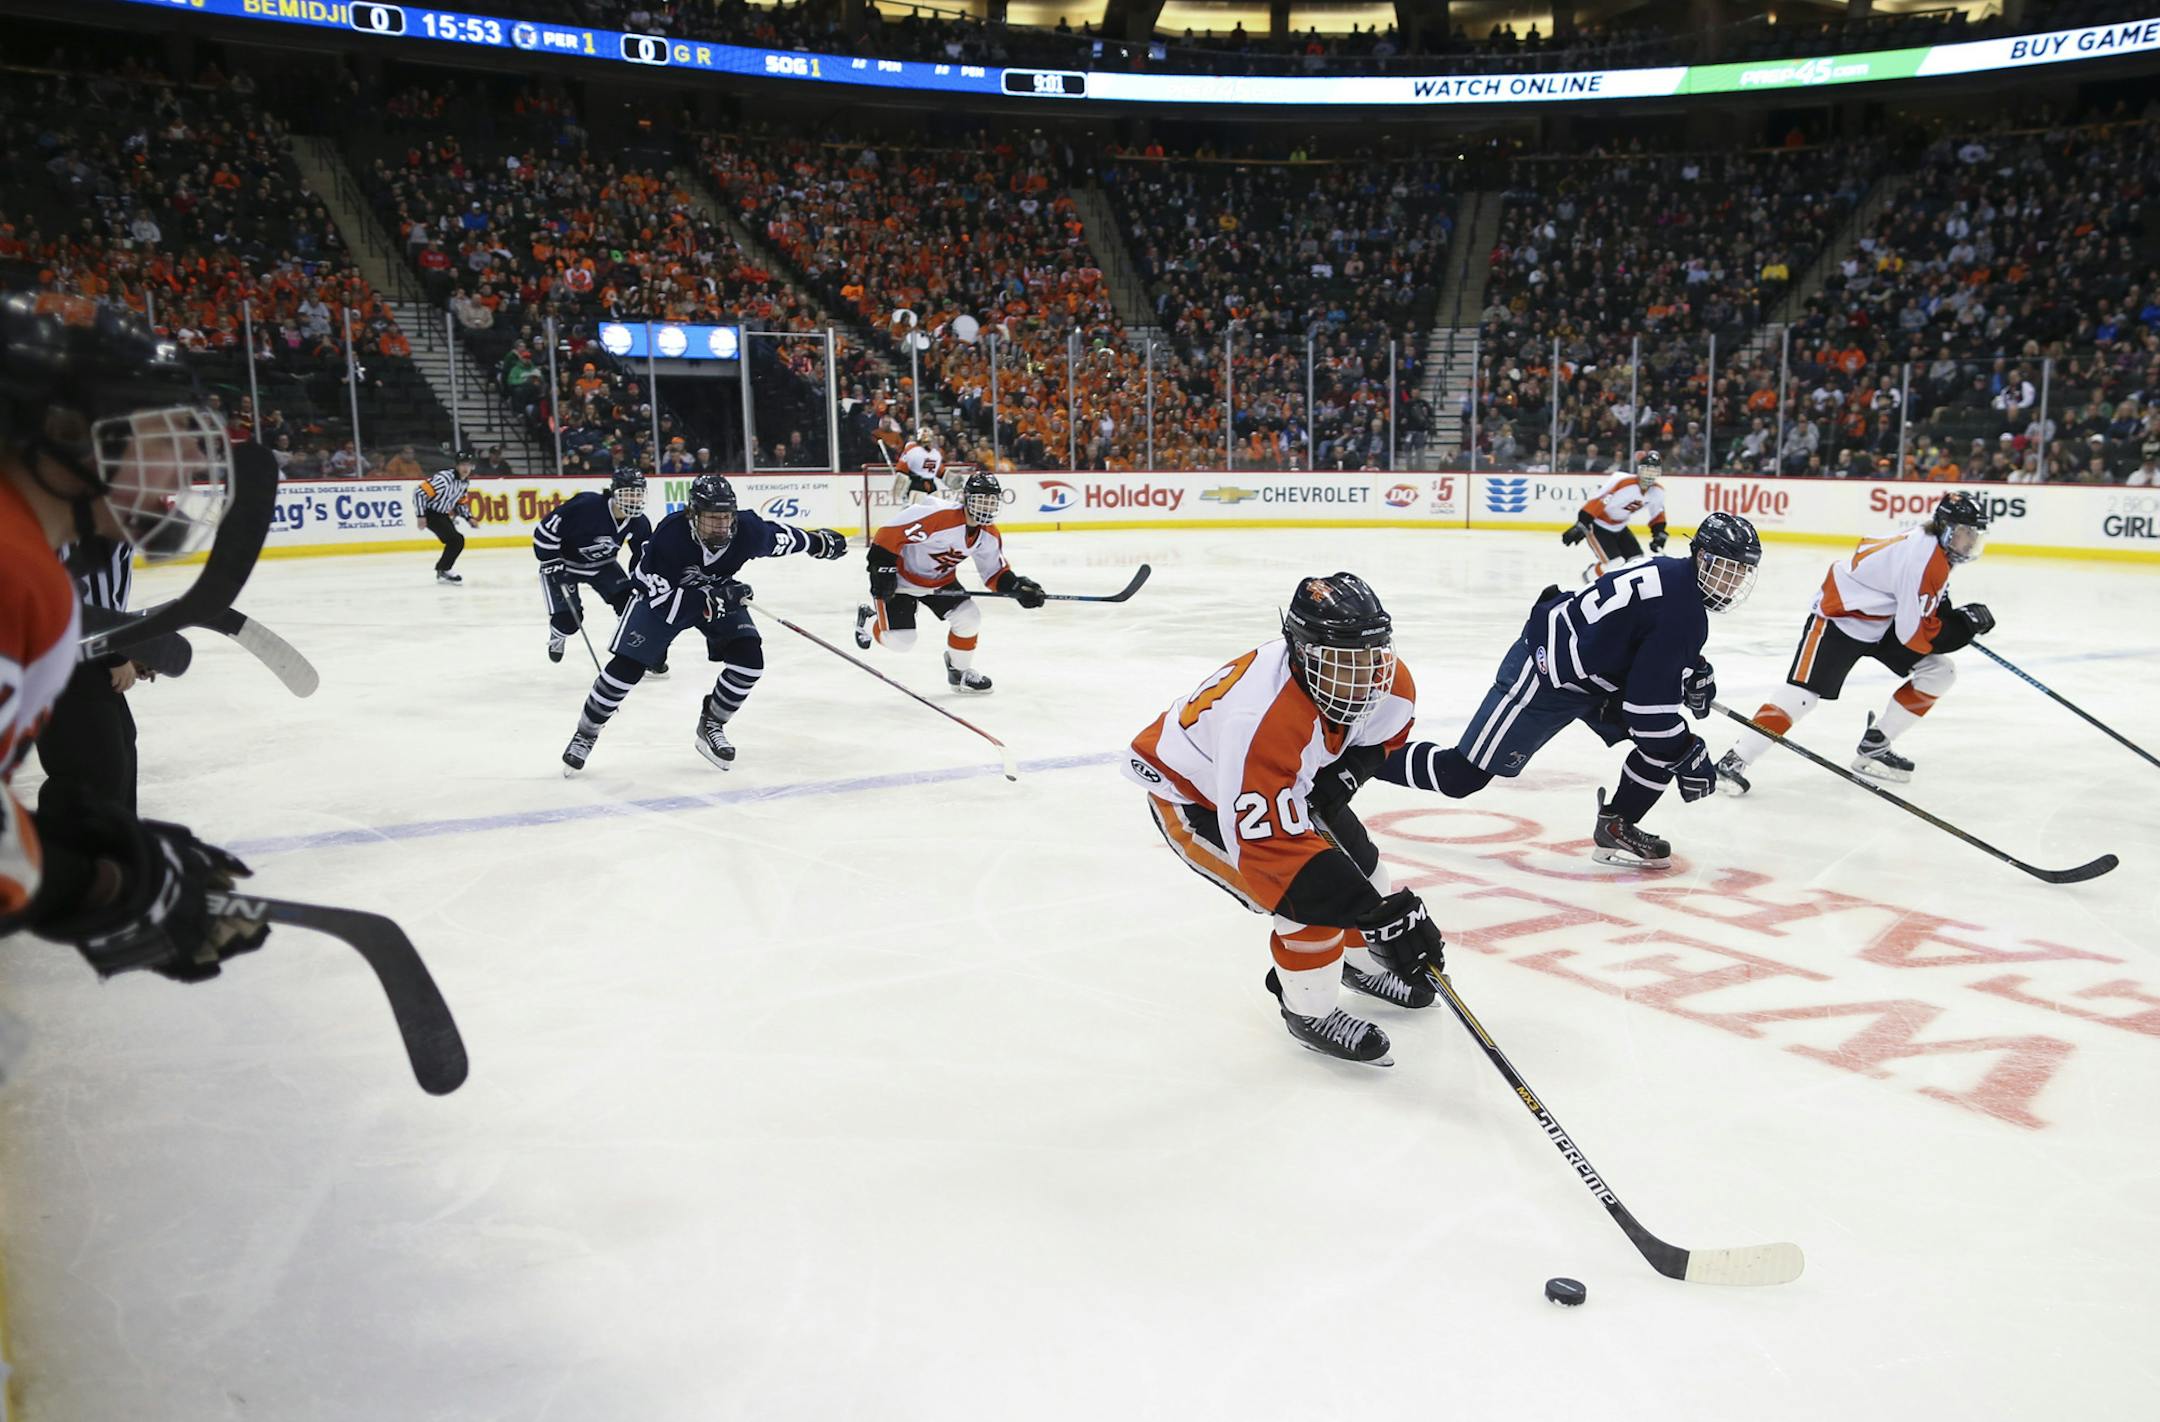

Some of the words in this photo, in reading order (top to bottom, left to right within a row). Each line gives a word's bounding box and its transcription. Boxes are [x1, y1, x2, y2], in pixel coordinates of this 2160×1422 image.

[244, 0, 347, 23] BEMIDJI
[370, 7, 389, 31] 0
[422, 13, 501, 44] 15:53
[543, 32, 578, 49] PER
[583, 33, 596, 54] 1
[638, 39, 655, 60] 0
[765, 55, 808, 75] SOG
[811, 59, 822, 77] 1
[2010, 34, 2069, 60] BUY
[1033, 74, 1065, 93] 9:01
[1414, 79, 1501, 97] WATCH
[1510, 75, 1603, 94] ONLINE
[747, 483, 799, 491] WEEKNIGHTS
[813, 482, 829, 490] 6PM
[1085, 483, 1185, 511] Holiday
[1262, 486, 1370, 503] CHEVROLET
[1535, 483, 1600, 500] POLY
[271, 496, 328, 529] ng's
[335, 494, 404, 520] Cove
[466, 489, 510, 523] Old
[768, 498, 800, 518] 45
[904, 522, 928, 542] 12
[1233, 786, 1307, 841] 20
[1515, 1085, 1541, 1112] MX3
[1536, 1110, 1618, 1207] SUPREME
